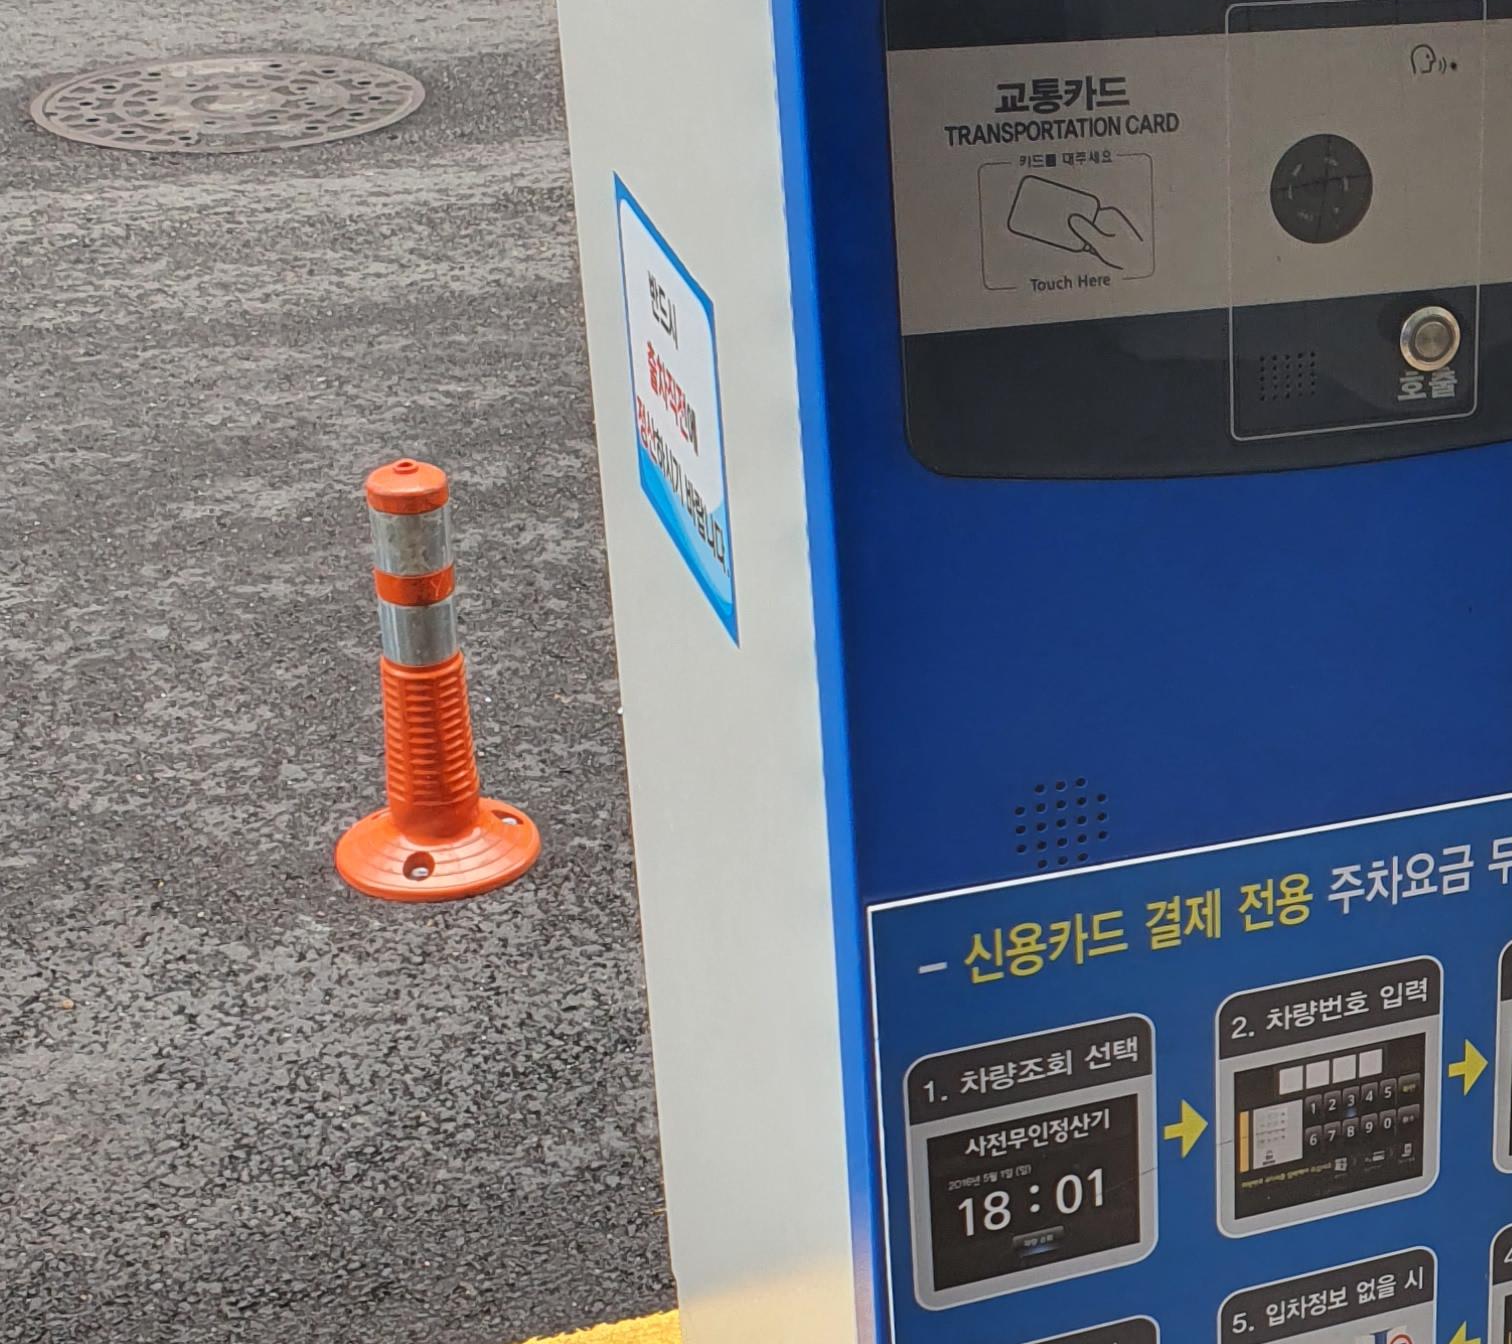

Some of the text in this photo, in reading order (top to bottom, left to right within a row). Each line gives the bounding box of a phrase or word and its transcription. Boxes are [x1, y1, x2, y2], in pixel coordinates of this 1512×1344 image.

[994, 76, 1130, 114] 교통카드
[944, 112, 1180, 146] TRANSPORTATION CARD
[647, 268, 679, 353] 반드시
[1029, 274, 1111, 292] Touch Here
[645, 335, 699, 460] 출차직전에
[1397, 366, 1459, 402] 호출
[964, 910, 1128, 986] 신용카드
[1146, 889, 1222, 951] 결제
[1237, 871, 1314, 936] 전용
[1327, 843, 1474, 917] 주차요금
[1231, 976, 1429, 1040] 2. 차량번호 입력
[923, 1036, 1138, 1103] 1. 차량조회 선택
[965, 1108, 1111, 1158] 사전무인정산기
[1232, 1266, 1425, 1334] 5. 입차정보 없을 시
